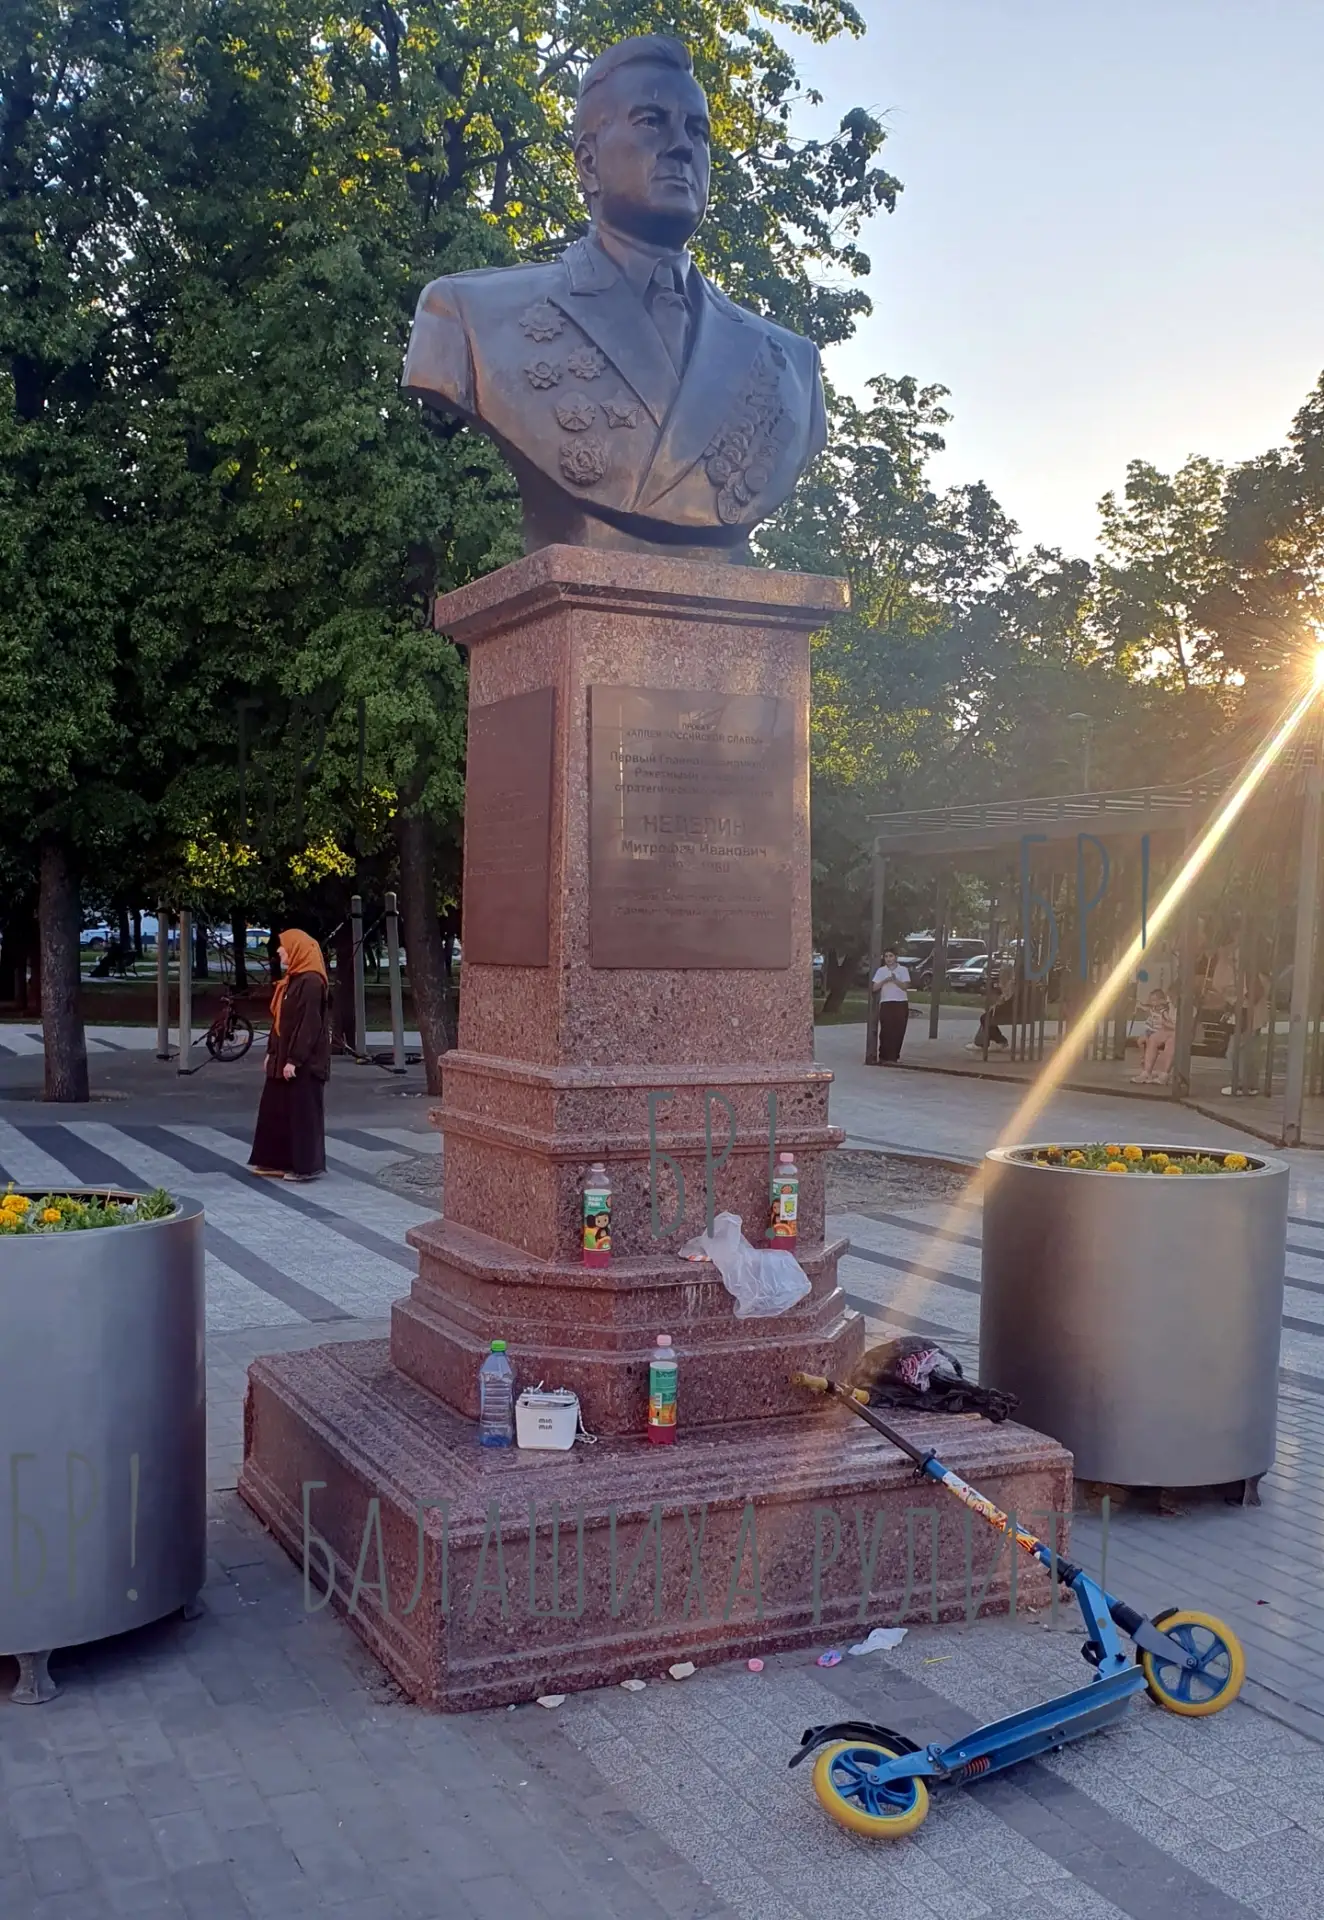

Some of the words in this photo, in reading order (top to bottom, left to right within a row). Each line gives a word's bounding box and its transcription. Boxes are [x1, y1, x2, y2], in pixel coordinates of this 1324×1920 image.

[610, 751, 656, 764] Первый
[643, 814, 746, 838] НЕДЕЛИН
[621, 840, 695, 857] Митрофан
[700, 843, 767, 858] Иванович
